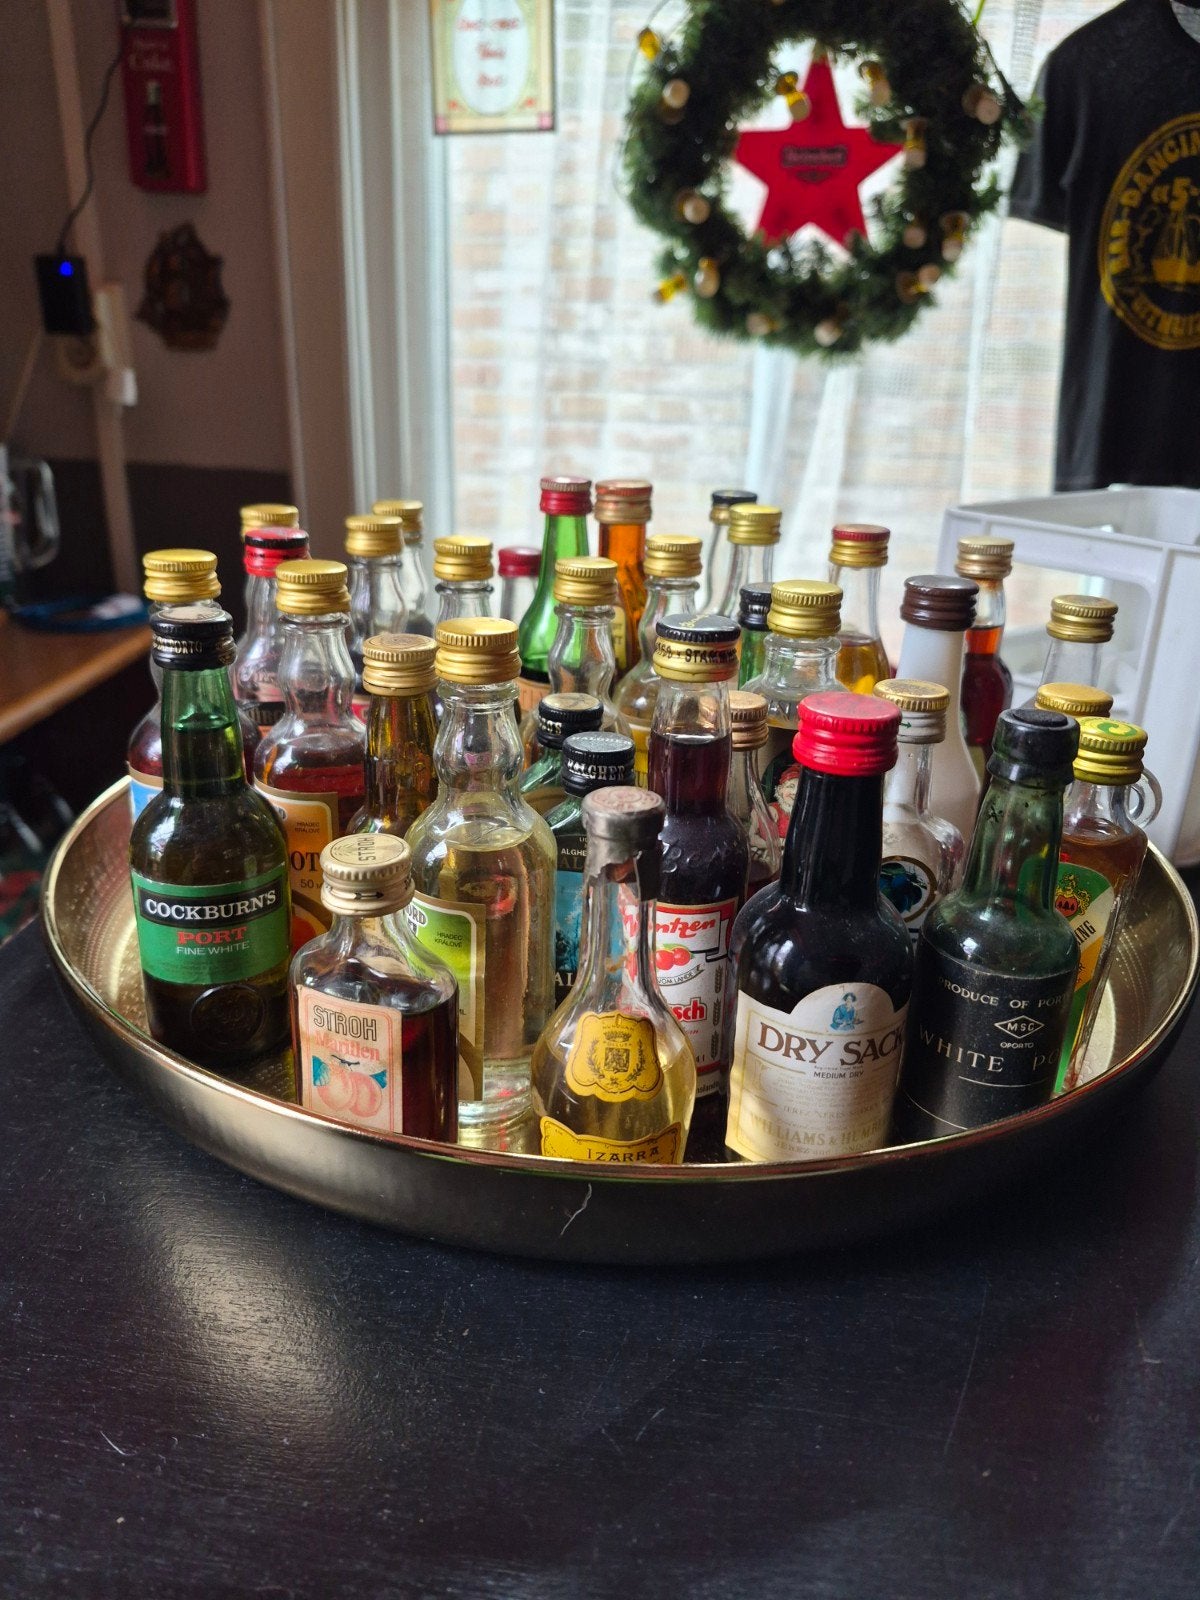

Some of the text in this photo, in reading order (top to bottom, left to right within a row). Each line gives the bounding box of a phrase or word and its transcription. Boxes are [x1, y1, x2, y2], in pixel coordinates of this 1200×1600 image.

[357, 837, 377, 862] STROH
[300, 880, 314, 889] 50
[145, 889, 277, 921] COCKBURN'S
[177, 926, 248, 946] PORT
[176, 940, 250, 956] FINE WHITE
[1009, 1000, 1030, 1009] OF
[313, 1004, 378, 1042] STROH
[1006, 1022, 1036, 1032] MSC
[757, 1022, 833, 1065] DRY
[919, 1024, 1005, 1073] WHITE
[814, 1069, 864, 1080] MEDIUM DRY
[587, 1147, 660, 1163] IZARRA
